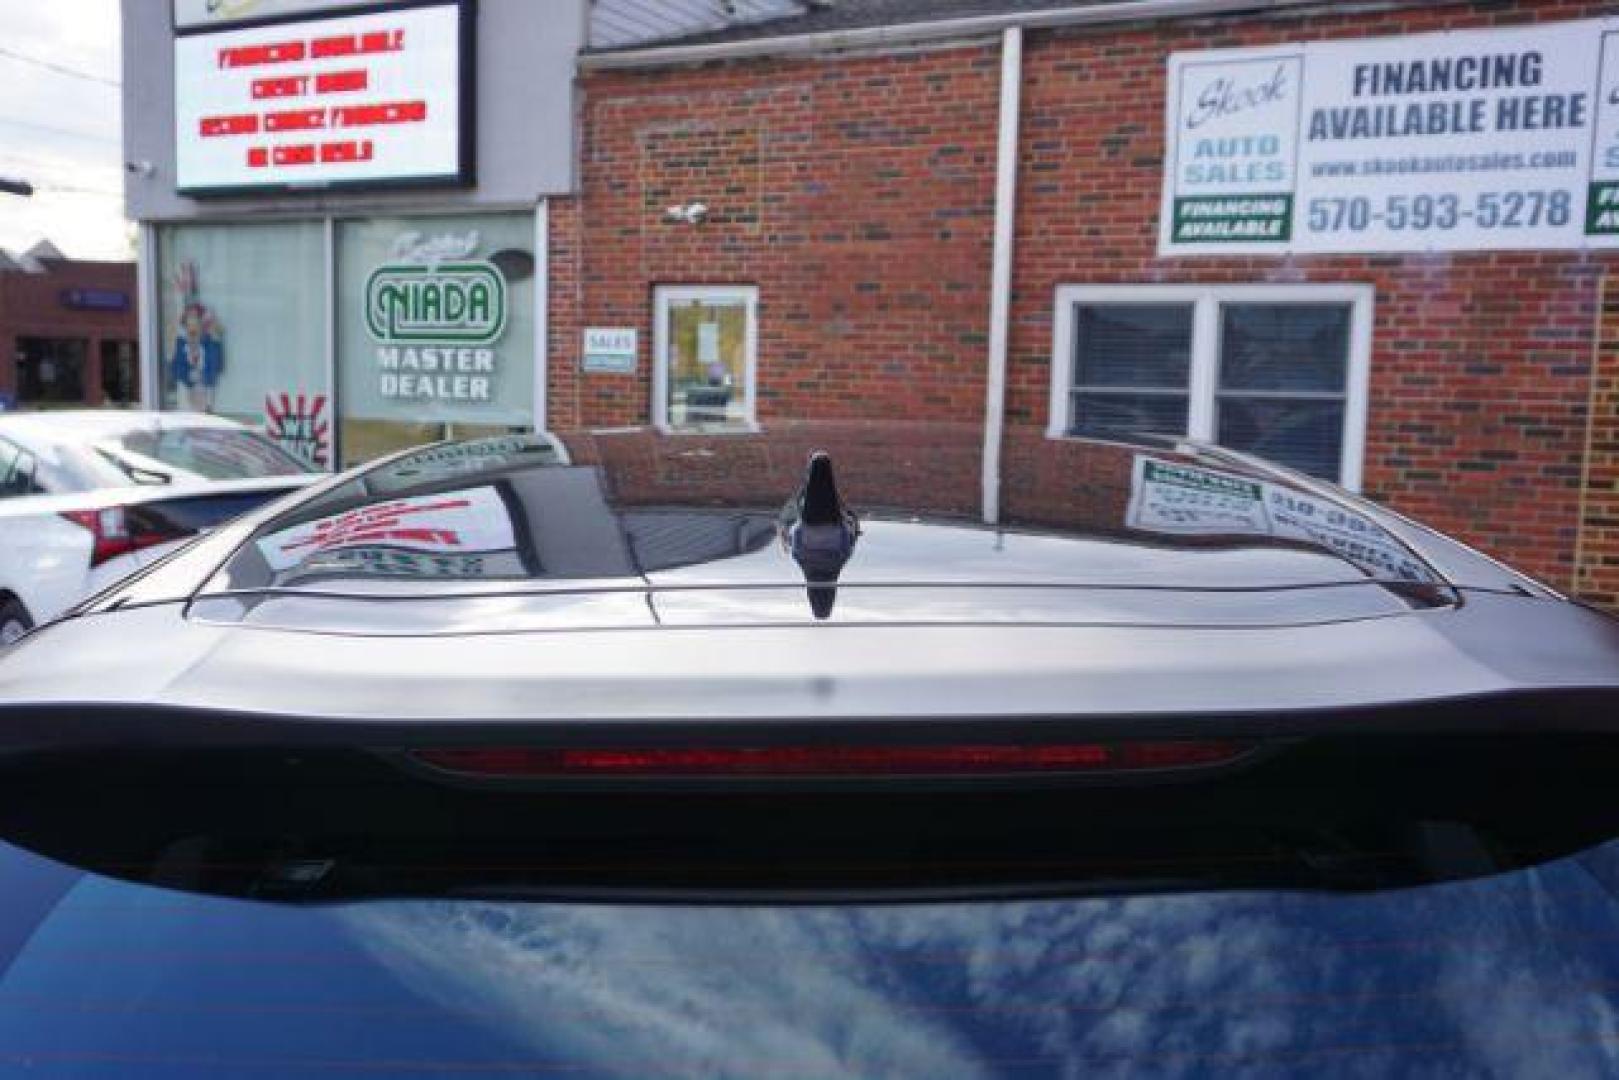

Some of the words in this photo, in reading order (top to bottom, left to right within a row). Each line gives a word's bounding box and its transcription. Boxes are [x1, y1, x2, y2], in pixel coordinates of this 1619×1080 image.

[1352, 51, 1543, 98] FINANCING
[1186, 62, 1288, 130] Skook
[1308, 99, 1487, 141] AVAILABLE
[1494, 93, 1587, 131] HERE
[1194, 134, 1280, 158] AUTO
[1184, 161, 1284, 184] SALES
[1311, 151, 1577, 177] www.skookautosales.com
[1308, 191, 1572, 231] 570-593-5278
[379, 282, 489, 322] NIADA
[377, 348, 496, 370] MASTER
[380, 374, 490, 399] DEALER
